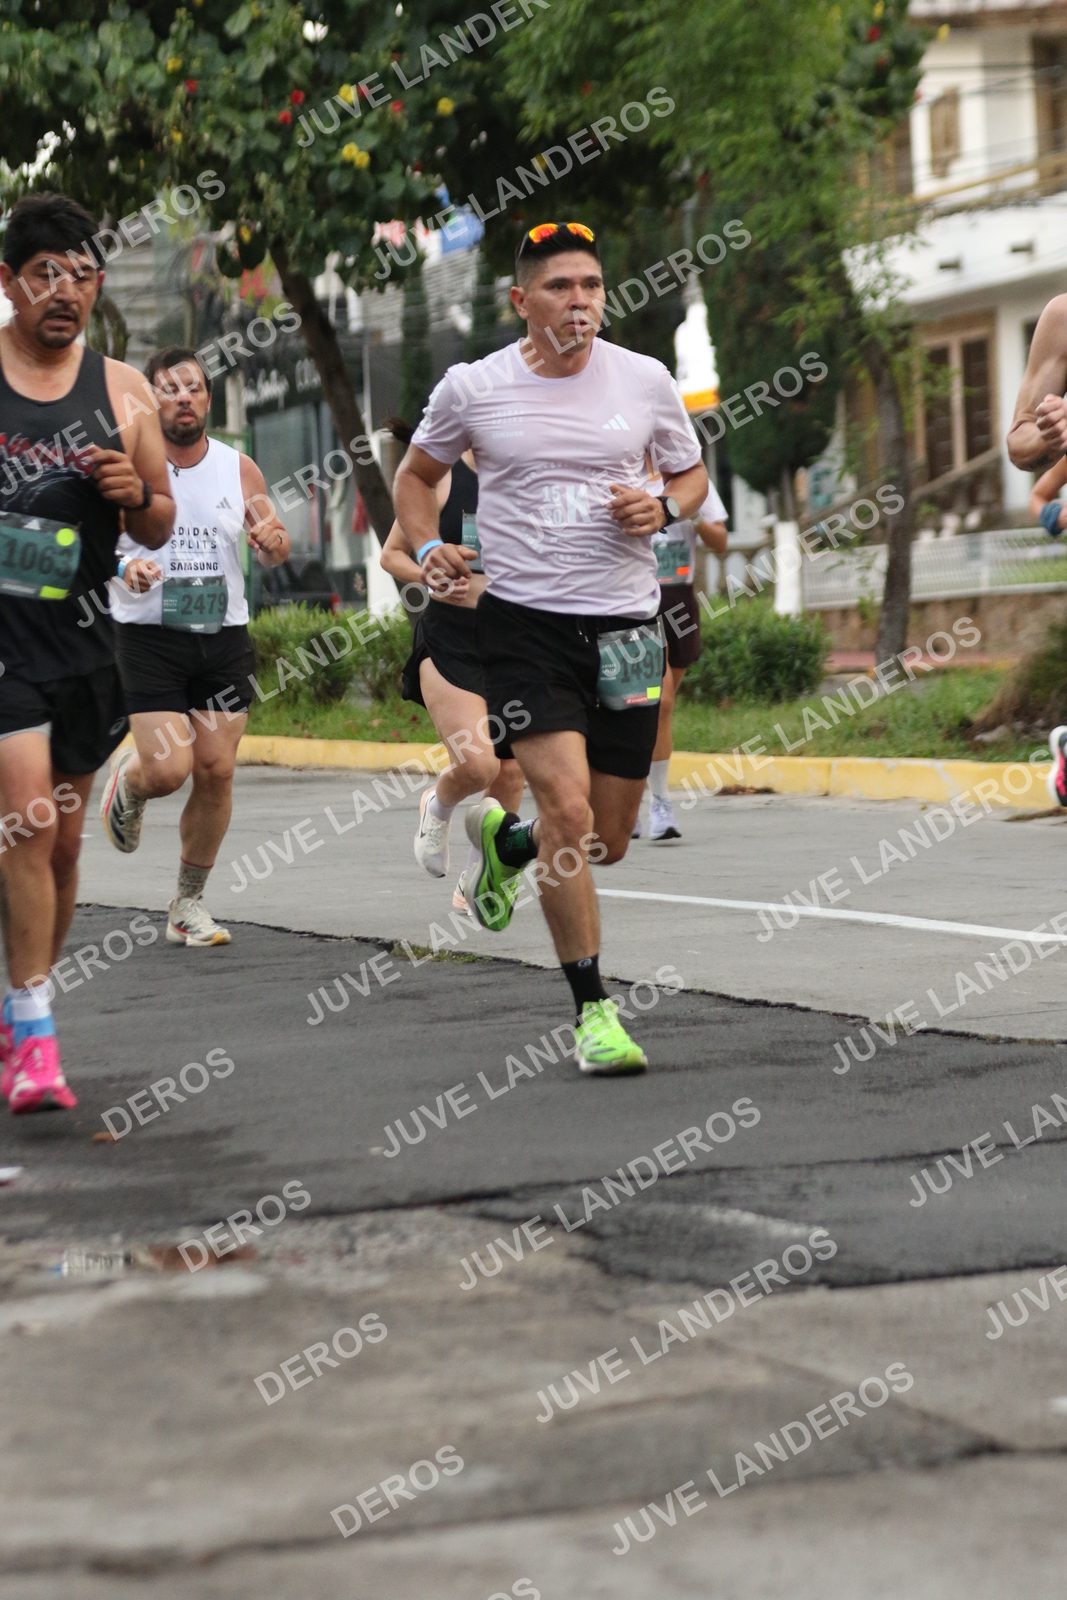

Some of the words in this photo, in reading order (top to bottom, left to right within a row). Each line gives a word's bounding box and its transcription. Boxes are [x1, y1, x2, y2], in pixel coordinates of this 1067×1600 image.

[171, 540, 217, 549] SPLITS
[170, 561, 218, 571] SAMSUNG
[181, 592, 227, 615] 2479
